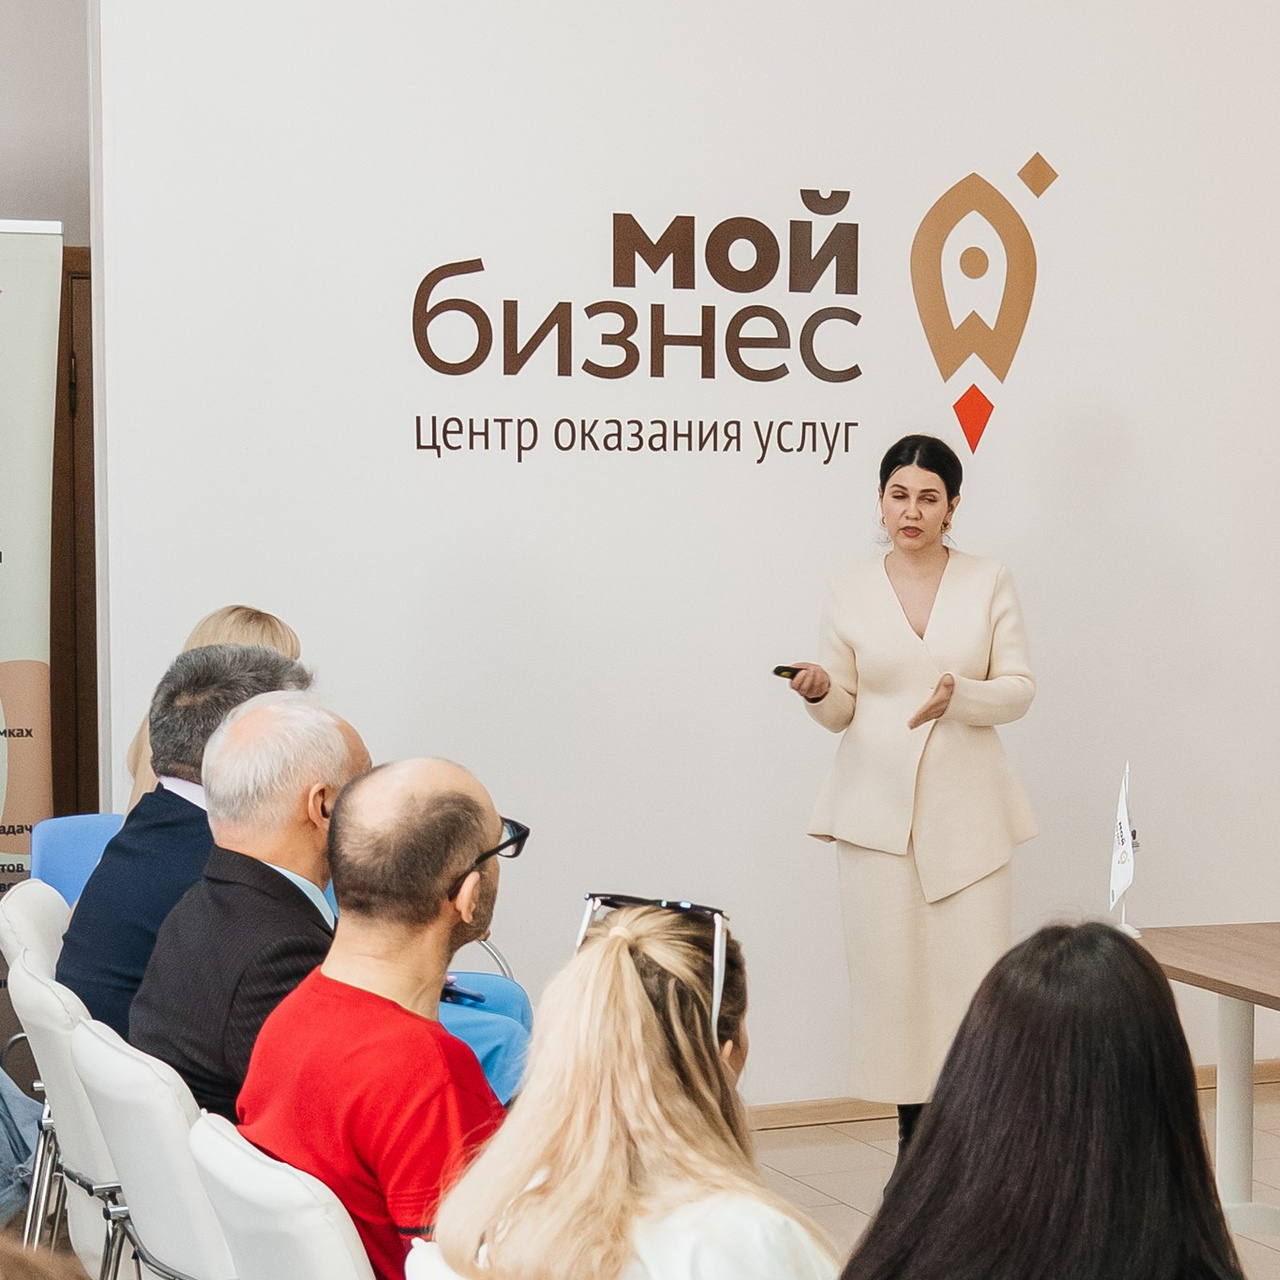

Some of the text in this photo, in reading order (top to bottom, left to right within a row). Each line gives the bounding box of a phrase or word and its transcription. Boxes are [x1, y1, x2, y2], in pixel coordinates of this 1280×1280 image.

[612, 188, 859, 296] мой
[411, 257, 863, 383] бизнес
[415, 415, 859, 465] центр оказания услуг
